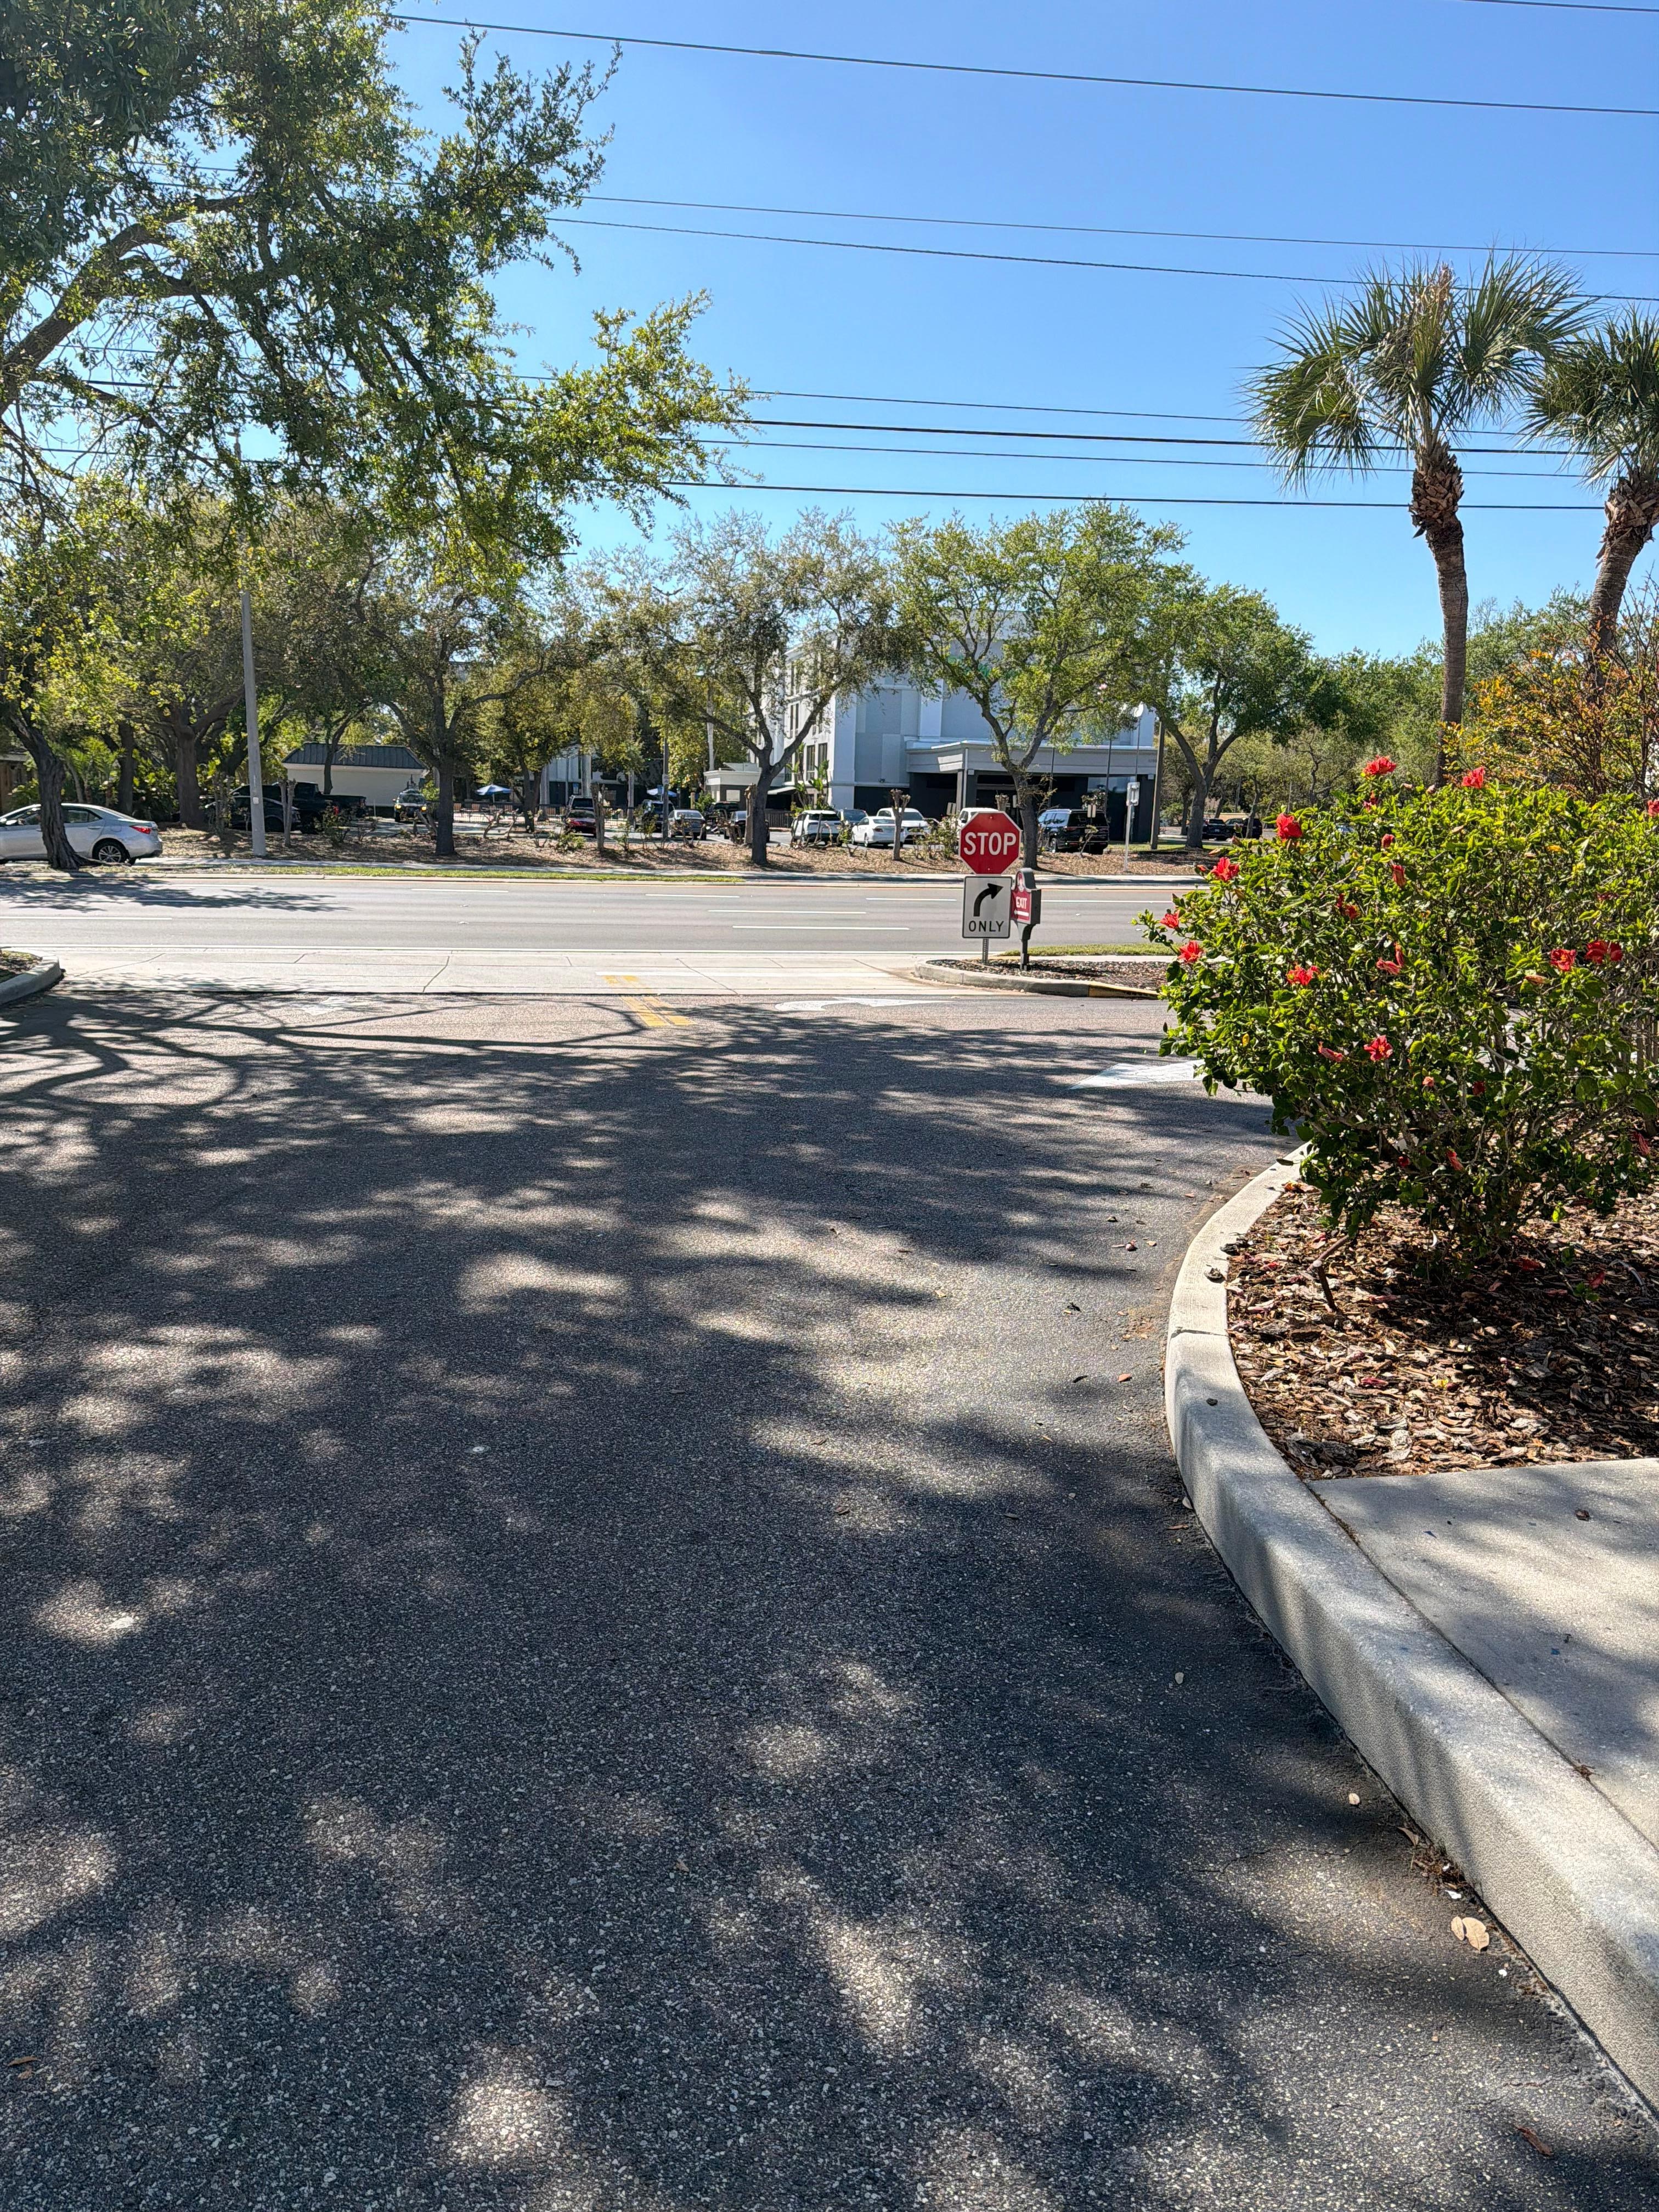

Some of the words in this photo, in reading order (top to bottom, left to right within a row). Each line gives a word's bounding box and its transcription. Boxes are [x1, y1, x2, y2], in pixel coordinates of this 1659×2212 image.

[963, 832, 1017, 855] STOP
[1015, 896, 1028, 909] EXIT
[968, 921, 1005, 932] ONLY
